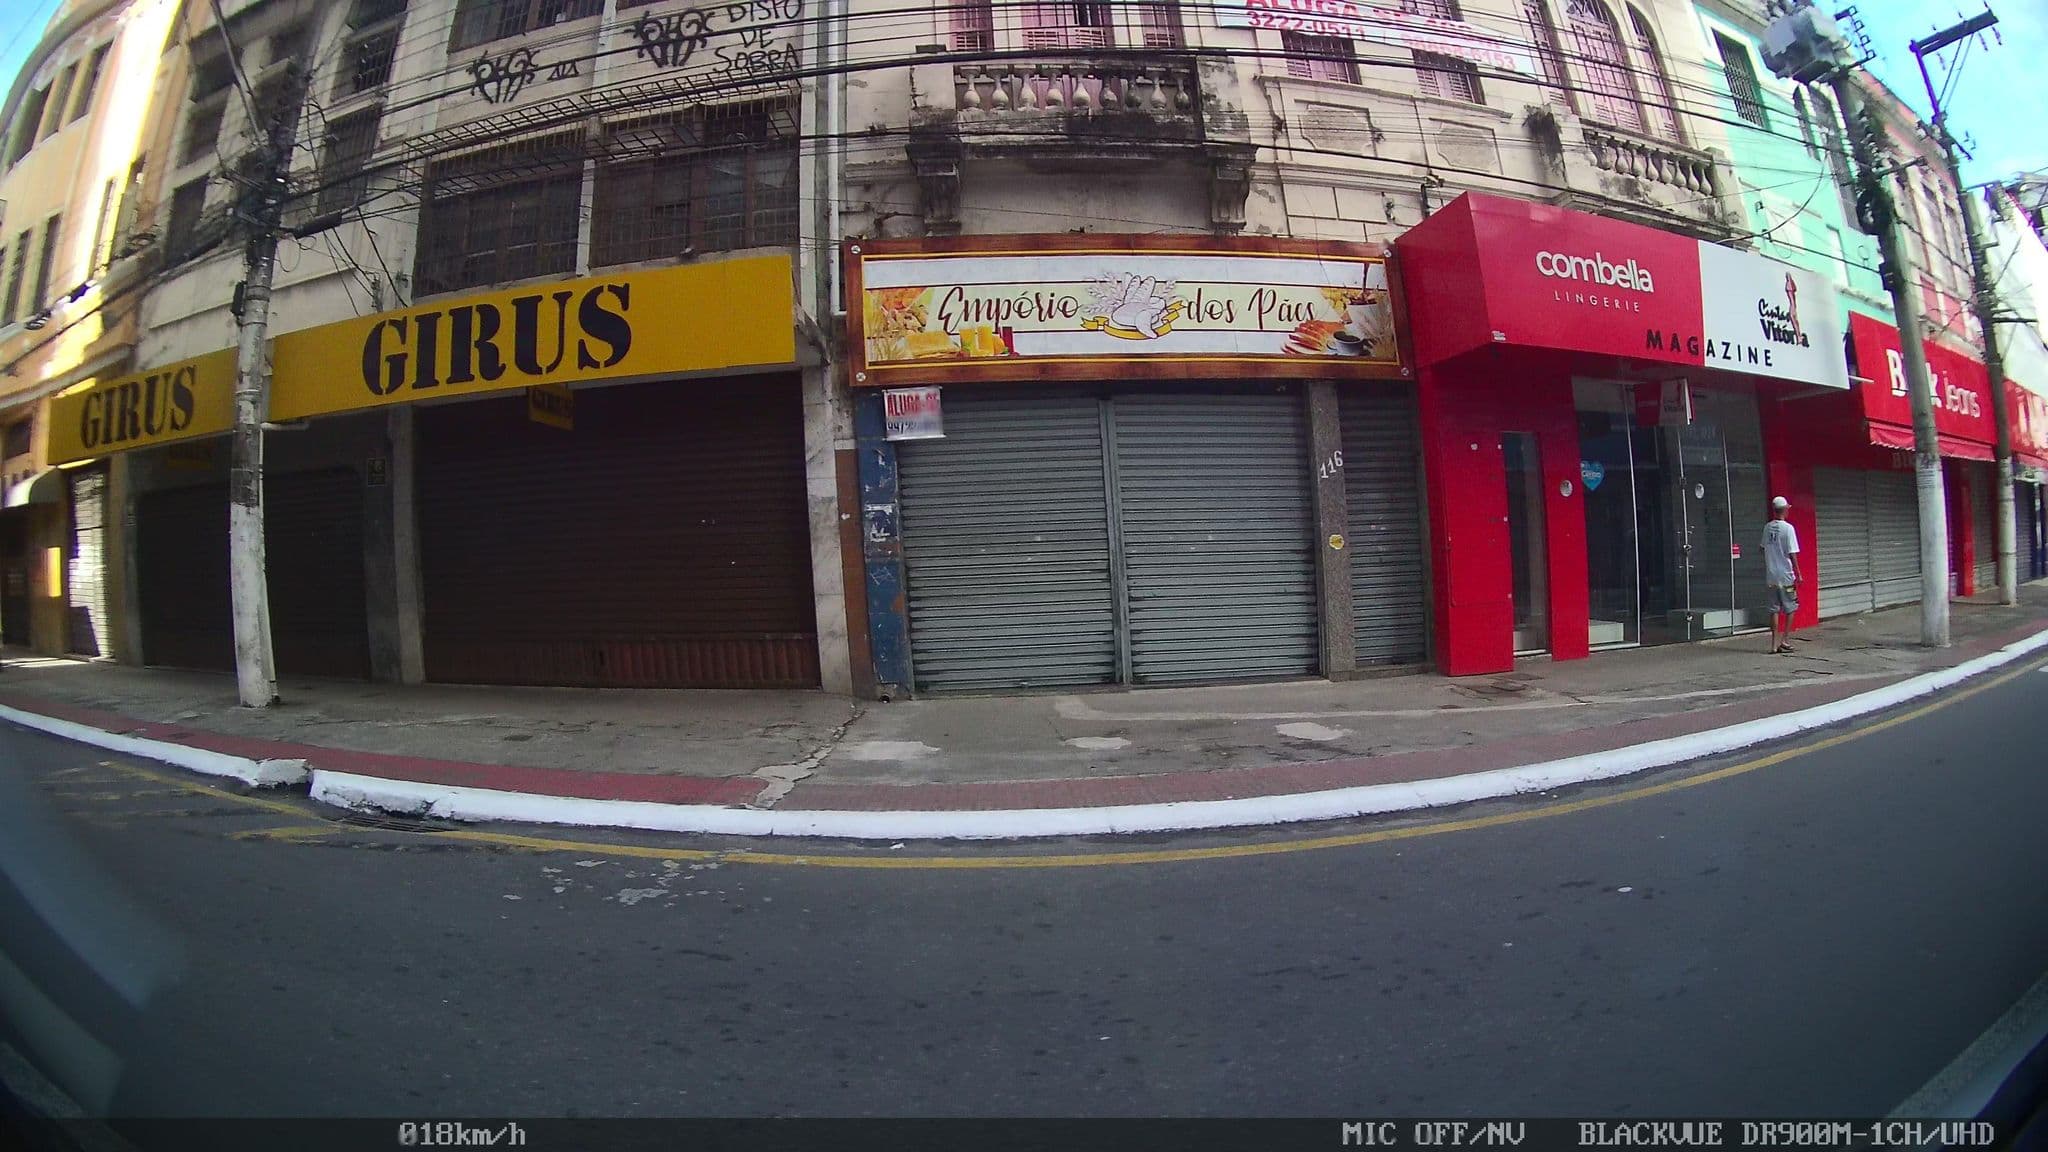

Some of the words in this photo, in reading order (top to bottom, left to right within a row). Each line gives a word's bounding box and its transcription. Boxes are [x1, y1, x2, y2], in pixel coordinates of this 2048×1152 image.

[1536, 251, 1654, 292] combella
[938, 286, 1079, 335] Empório
[1186, 288, 1236, 323] dos
[1554, 290, 1640, 313] LINGERIE
[362, 282, 632, 396] GIRUS
[1646, 329, 1773, 367] MAGAZINE
[79, 364, 198, 449] GIRUS
[1320, 450, 1343, 479] 116
